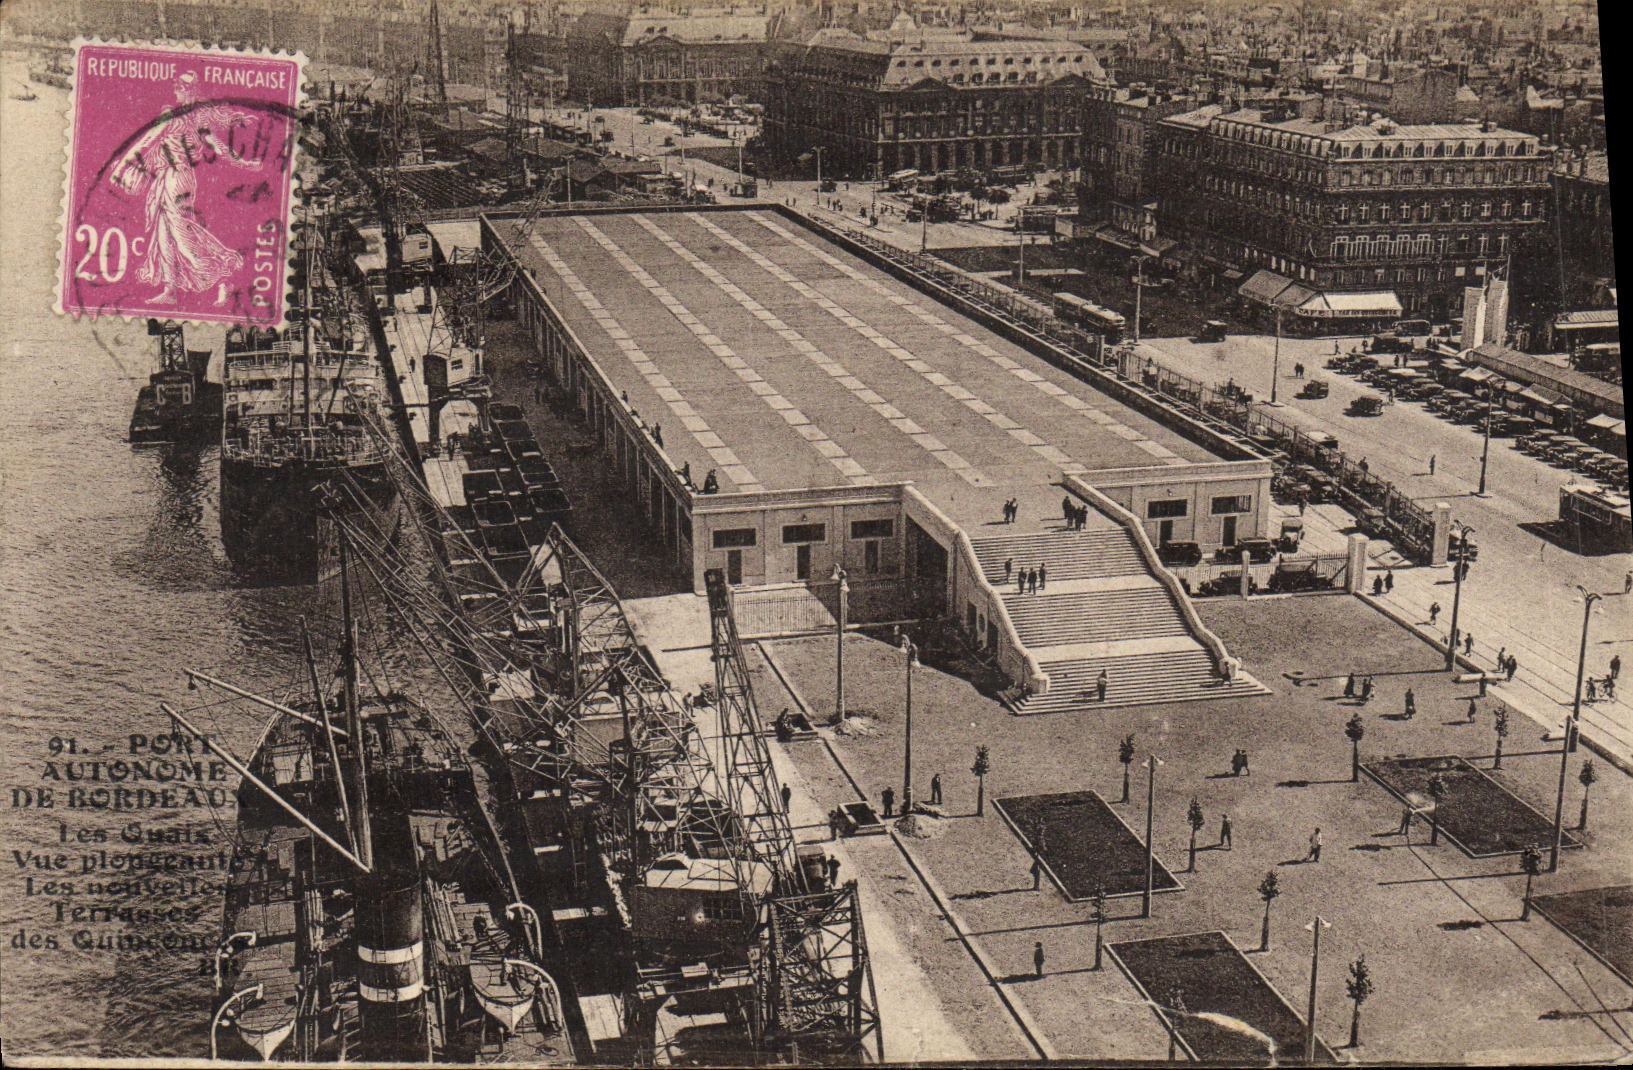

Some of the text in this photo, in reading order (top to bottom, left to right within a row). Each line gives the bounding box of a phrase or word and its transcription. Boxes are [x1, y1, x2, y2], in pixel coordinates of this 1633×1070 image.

[88, 57, 286, 90] REPUBLIQUE FRANÇAISE
[252, 223, 277, 308] POSTES
